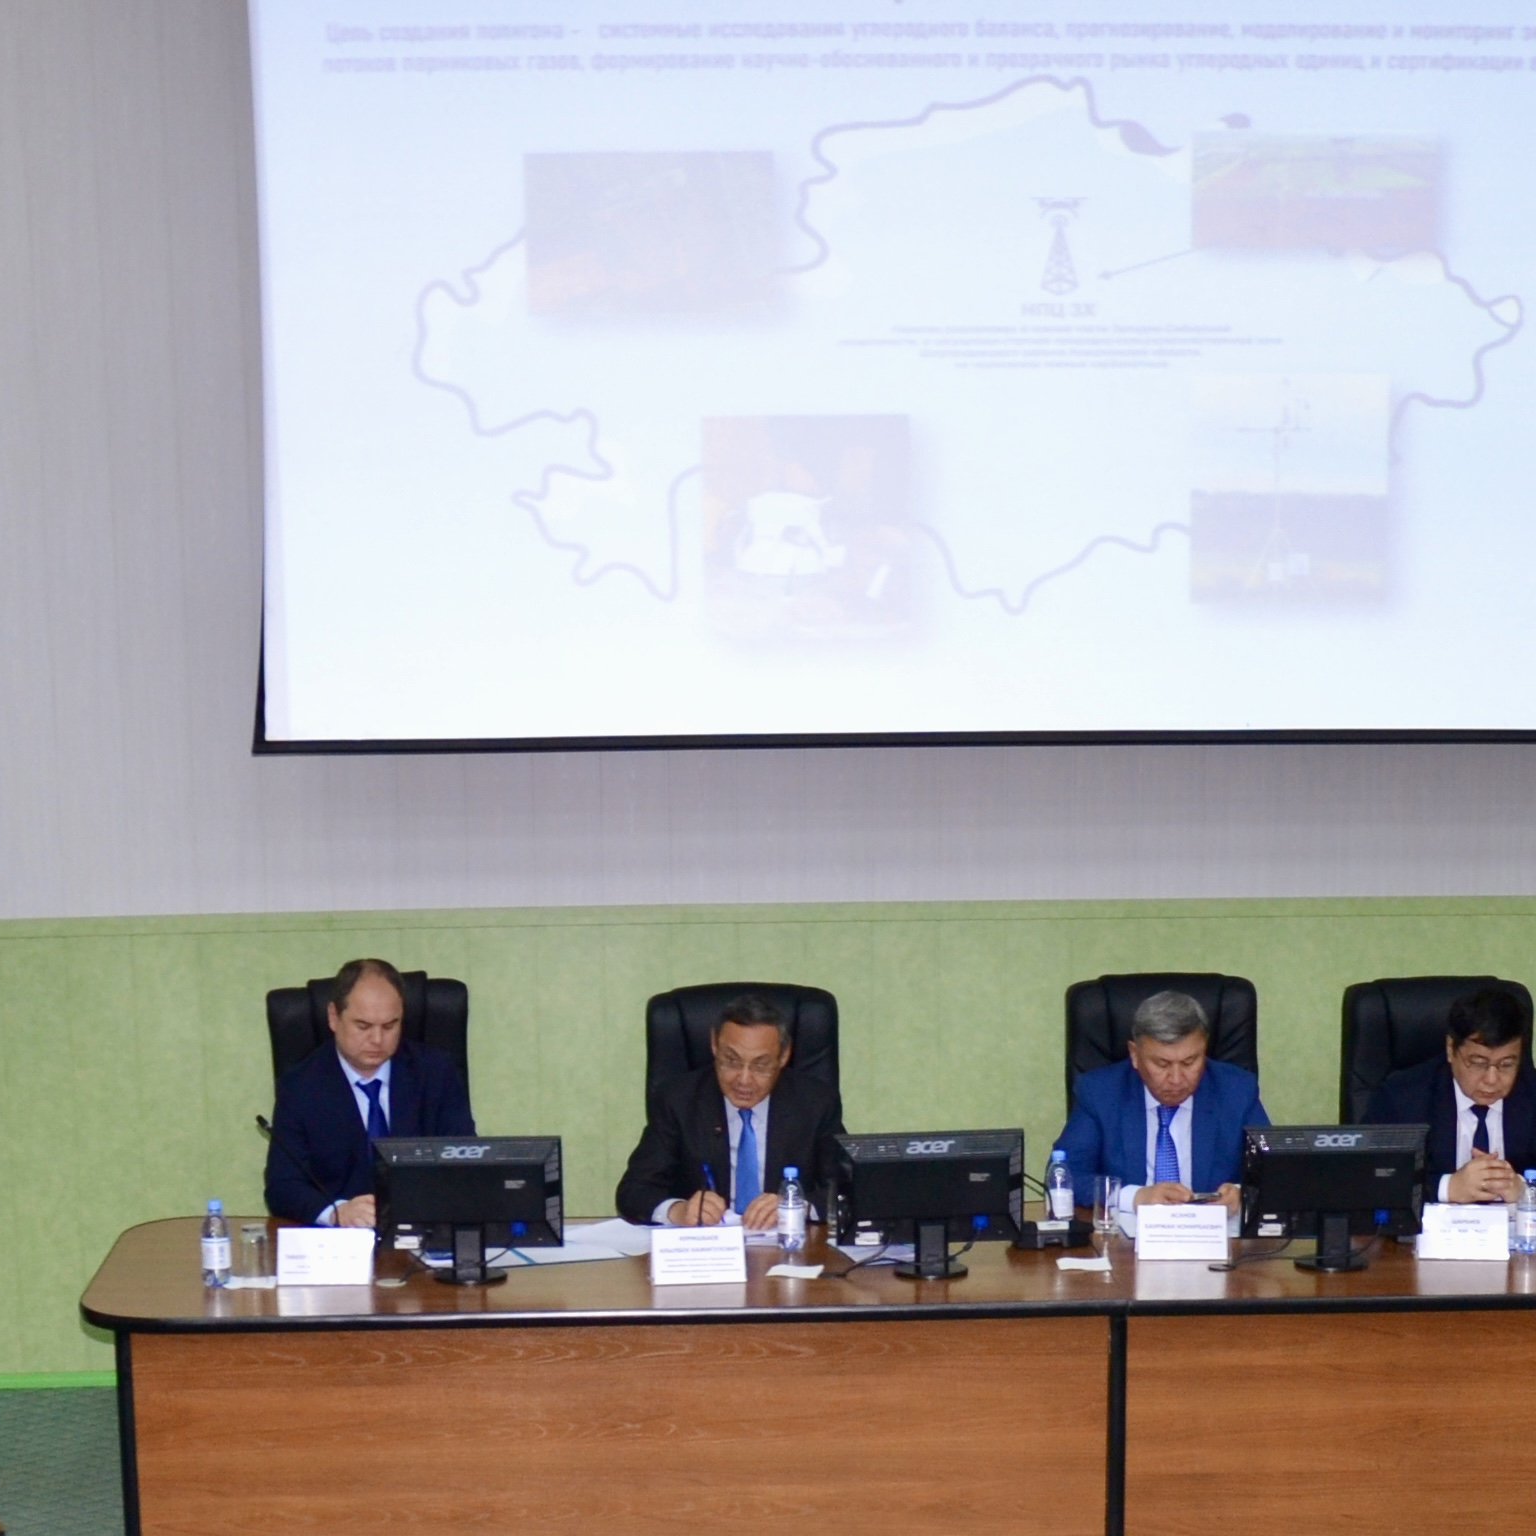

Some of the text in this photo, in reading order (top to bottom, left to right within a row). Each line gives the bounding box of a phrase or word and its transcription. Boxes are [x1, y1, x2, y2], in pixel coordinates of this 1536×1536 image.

[905, 1140, 955, 1155] acer
[1314, 1134, 1362, 1147] acer
[440, 1145, 491, 1159] acer
